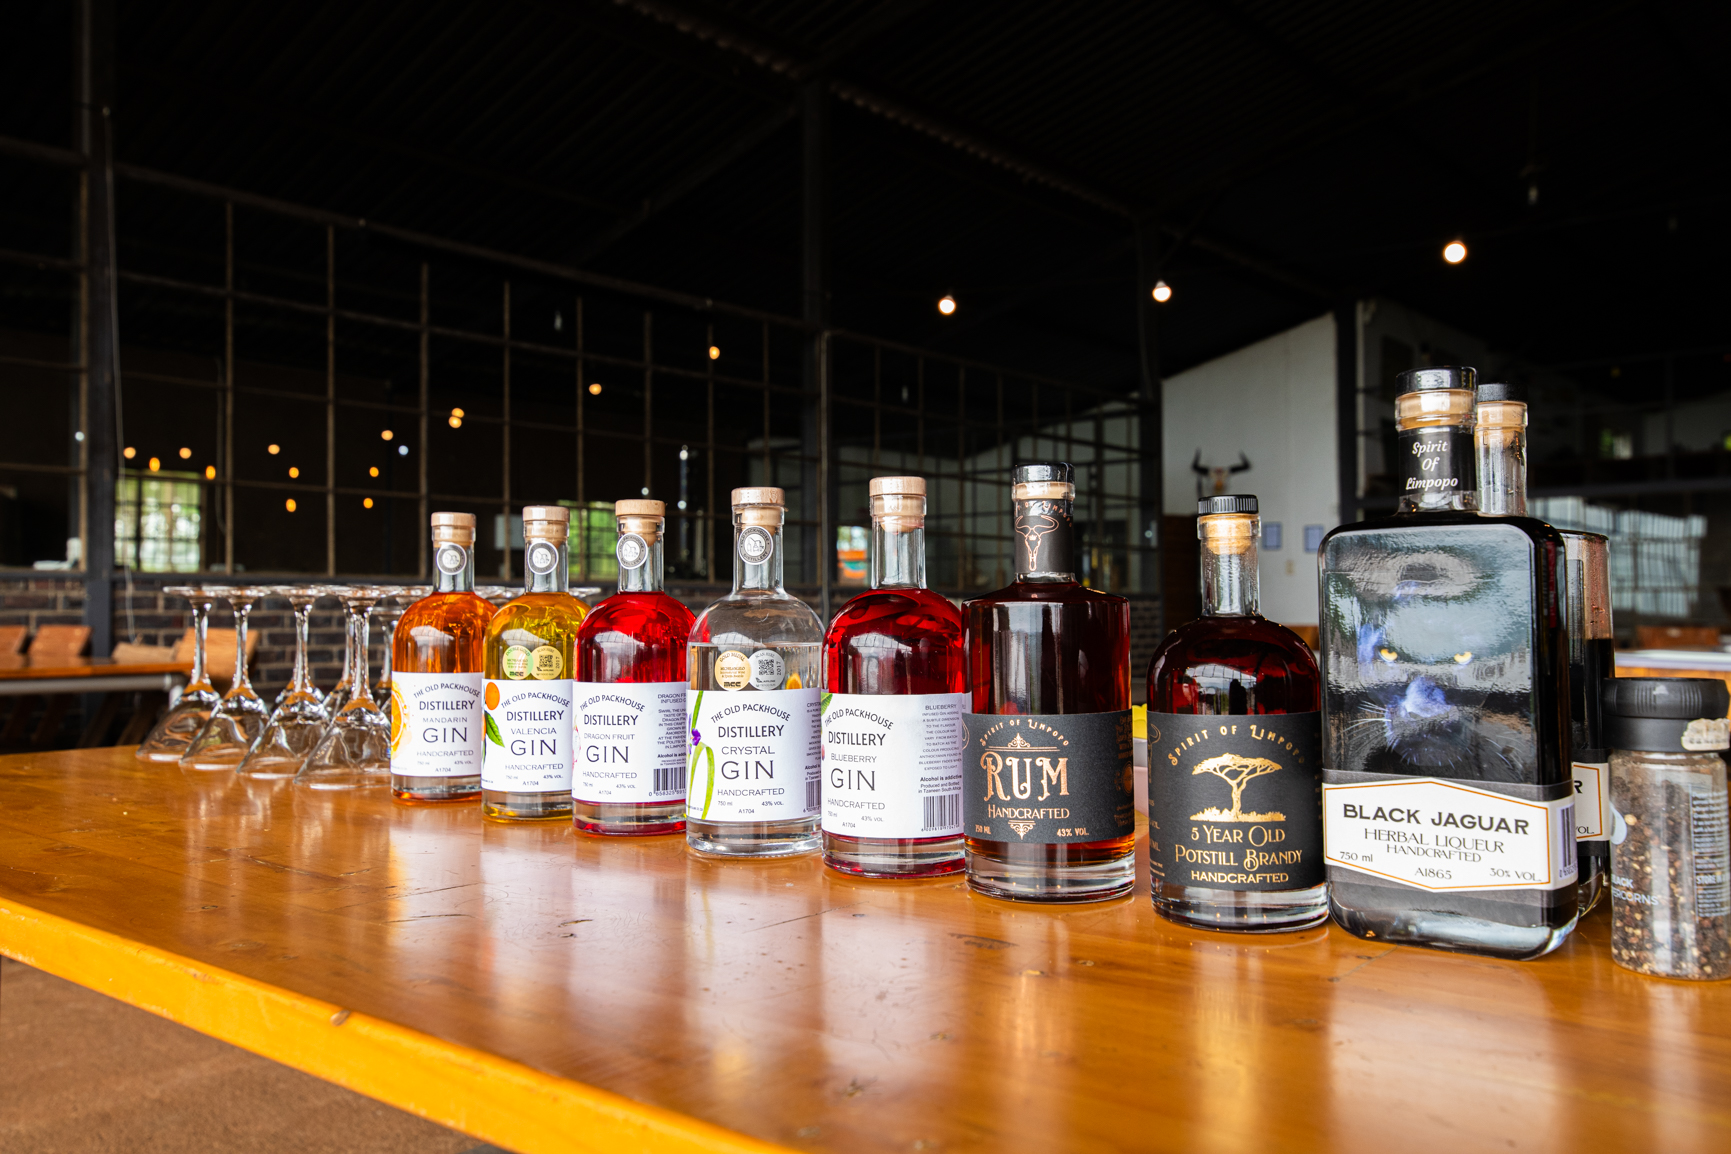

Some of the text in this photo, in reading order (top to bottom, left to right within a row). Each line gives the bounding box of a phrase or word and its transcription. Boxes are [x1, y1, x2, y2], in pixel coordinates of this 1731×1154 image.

[1412, 440, 1448, 457] Spirit
[1421, 456, 1440, 471] Of
[1406, 477, 1458, 491] Limpopo
[414, 683, 481, 698] THE OLD PACKHOUSE
[420, 700, 475, 710] DISTILLERY
[501, 692, 570, 708] THE OLD PACKHOUSE
[580, 695, 645, 712] THE OLD PACKHOUSE
[507, 710, 564, 721] DISTILLERY
[584, 715, 638, 725] DISTILLERY
[711, 704, 790, 724] THE OLD PACKHOUSE
[832, 708, 844, 720] OLD
[846, 708, 894, 730] PACKHOUSE
[423, 727, 467, 743] GIN
[718, 725, 784, 738] DISTILLERY
[829, 731, 886, 746] DISTILLERY
[980, 722, 1004, 746] SPIRIT
[1028, 719, 1069, 746] LIMPOPO
[511, 739, 556, 756] GIN
[722, 746, 775, 755] CRYSTAL
[1168, 729, 1208, 766] SPIRIT
[1220, 725, 1237, 735] OF
[1250, 724, 1304, 764] LIMPOPO
[586, 745, 628, 763] GIN
[831, 753, 877, 763] BLUEBERRY
[721, 760, 774, 779] GIN
[980, 751, 1070, 801] RUM
[831, 768, 875, 791] GIN
[718, 788, 784, 796] HANDCRAFTED
[828, 798, 885, 810] HANDCRAFTED
[988, 804, 1070, 819] HANDCRAFTED
[1343, 803, 1529, 835] BLACK JAGUAR
[1057, 827, 1089, 836] 43% VOL.
[1191, 824, 1285, 847] 5 YEAR OLD
[1364, 828, 1504, 854] HERBAL LIQUEUR
[1175, 844, 1238, 866] POTSTILL
[1244, 849, 1302, 871] BRANDY
[1340, 851, 1373, 862] 750 ml
[1386, 843, 1481, 863] HANDCRAFTED
[1191, 870, 1289, 883] HANDCRAFTED
[1490, 868, 1541, 882] 30% VOL.
